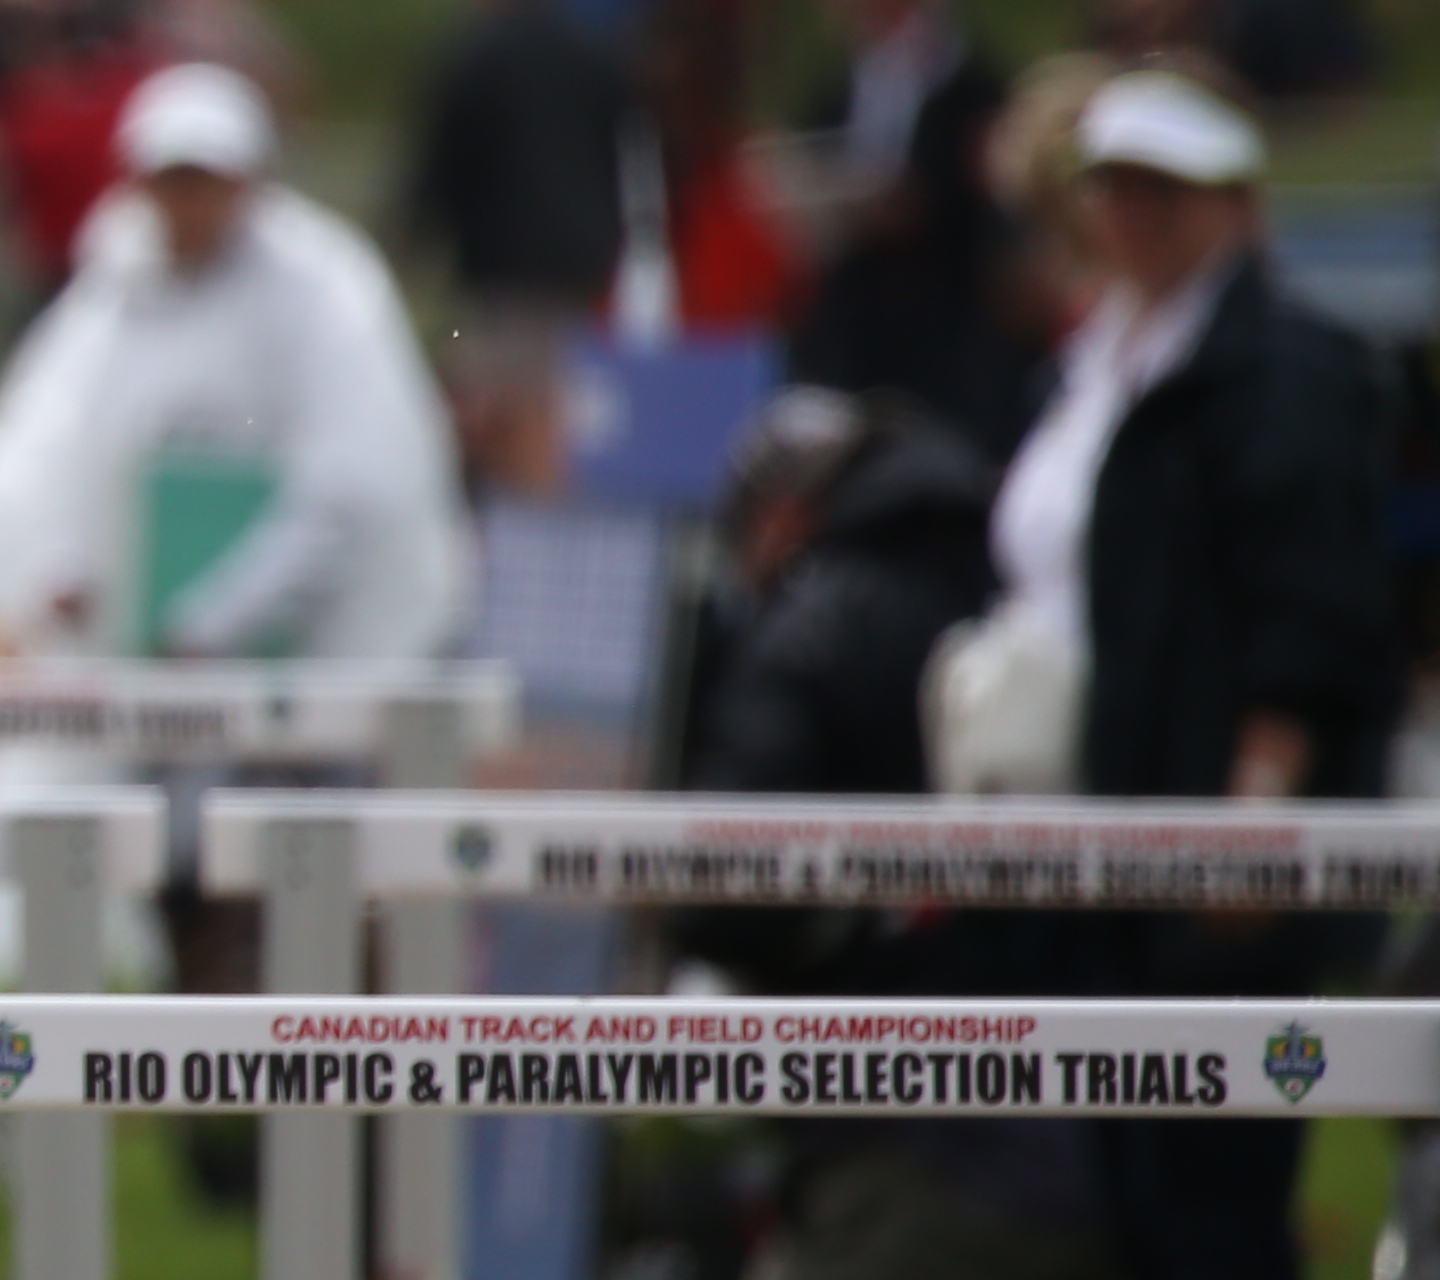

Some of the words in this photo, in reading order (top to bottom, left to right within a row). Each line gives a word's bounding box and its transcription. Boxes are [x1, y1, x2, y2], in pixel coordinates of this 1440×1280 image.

[271, 1016, 449, 1042] CANADIAN
[462, 1016, 574, 1042] TRACK
[586, 1016, 657, 1042] AND
[668, 1016, 764, 1042] FIELD
[775, 1016, 1036, 1043] CHAMPIONSHIP
[84, 1051, 167, 1103] RIO
[182, 1051, 393, 1104] OLYMPIC
[408, 1060, 443, 1105] &
[457, 1051, 765, 1106] PARALYMPIC
[779, 1052, 1042, 1106] SELECTION
[1054, 1053, 1228, 1107] TRIALS
